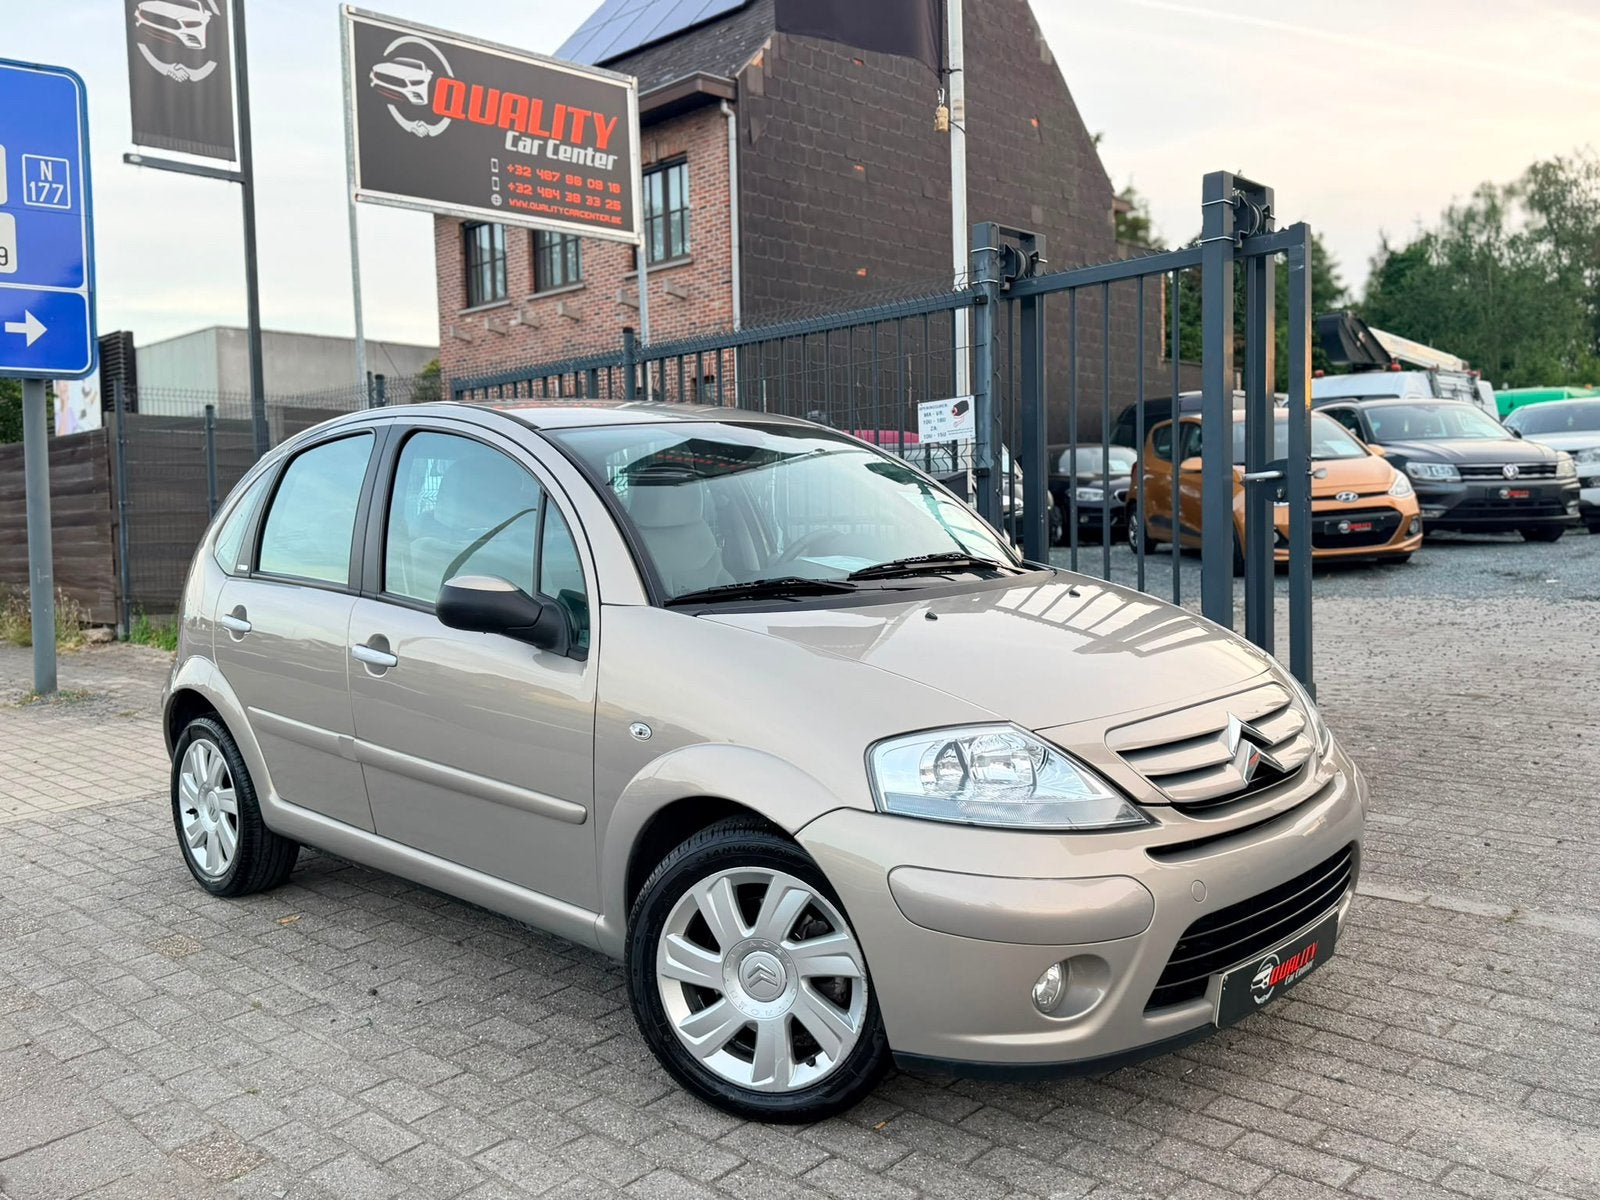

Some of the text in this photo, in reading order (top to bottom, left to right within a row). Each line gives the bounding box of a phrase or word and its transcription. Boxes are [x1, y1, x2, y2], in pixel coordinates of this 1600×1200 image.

[432, 77, 617, 150] QUALITY
[505, 130, 618, 170] Car Center
[40, 160, 53, 181] N
[507, 164, 532, 177] +32
[536, 169, 560, 182] 487
[587, 178, 604, 191] 09
[29, 181, 64, 203] 177
[508, 182, 621, 211] +32 484 38 33 25
[1269, 940, 1318, 987] QUALITY
